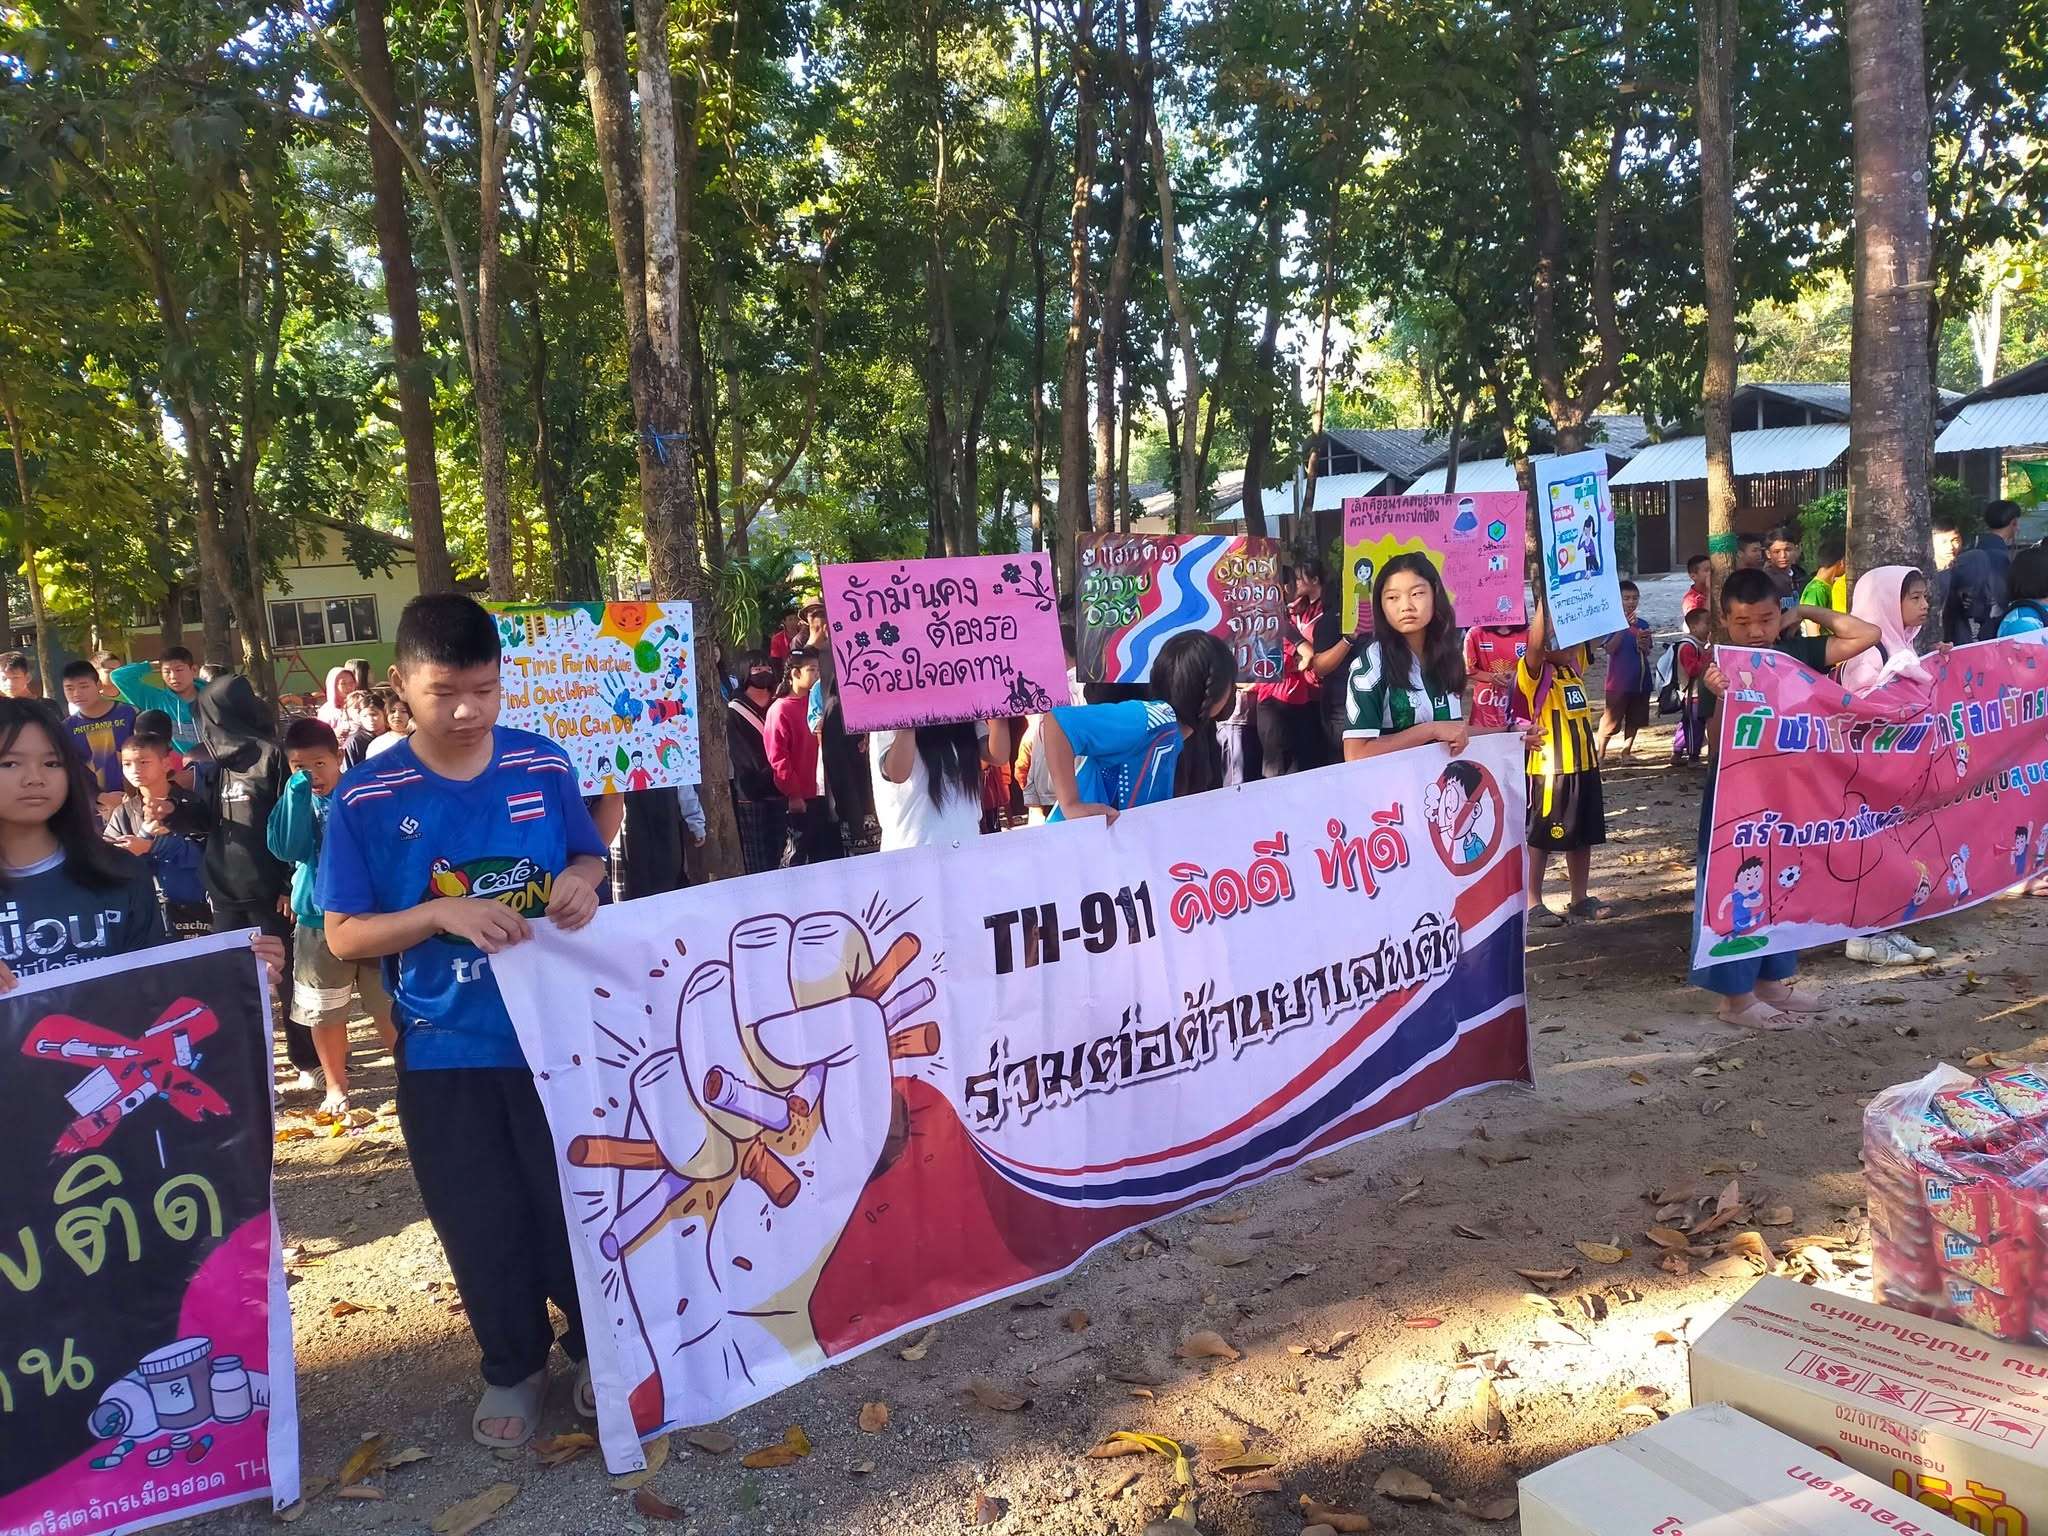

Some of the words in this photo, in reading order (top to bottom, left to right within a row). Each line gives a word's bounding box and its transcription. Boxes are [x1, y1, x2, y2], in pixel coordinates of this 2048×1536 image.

[842, 565, 979, 622] รักมั่นคง
[926, 610, 1017, 648] ต้องรอ
[862, 647, 1014, 694] ด้วยใจอดทน
[543, 712, 578, 738] You
[983, 881, 1156, 975] TH-911
[1169, 832, 1293, 932] คิดดี
[1314, 802, 1410, 898] ทำดี
[451, 958, 488, 984] tr
[964, 912, 1462, 1131] ร่วมต่อต้านยาเสพติด
[1760, 1324, 1795, 1339] USEFUL
[1798, 1336, 1828, 1348] FOOD
[1961, 1386, 2001, 1404] USEFUL
[2007, 1401, 2040, 1414] FOOD
[1839, 1430, 1945, 1473] ขนมทอดกรอบ
[1785, 1465, 1936, 1536] ของแตก
